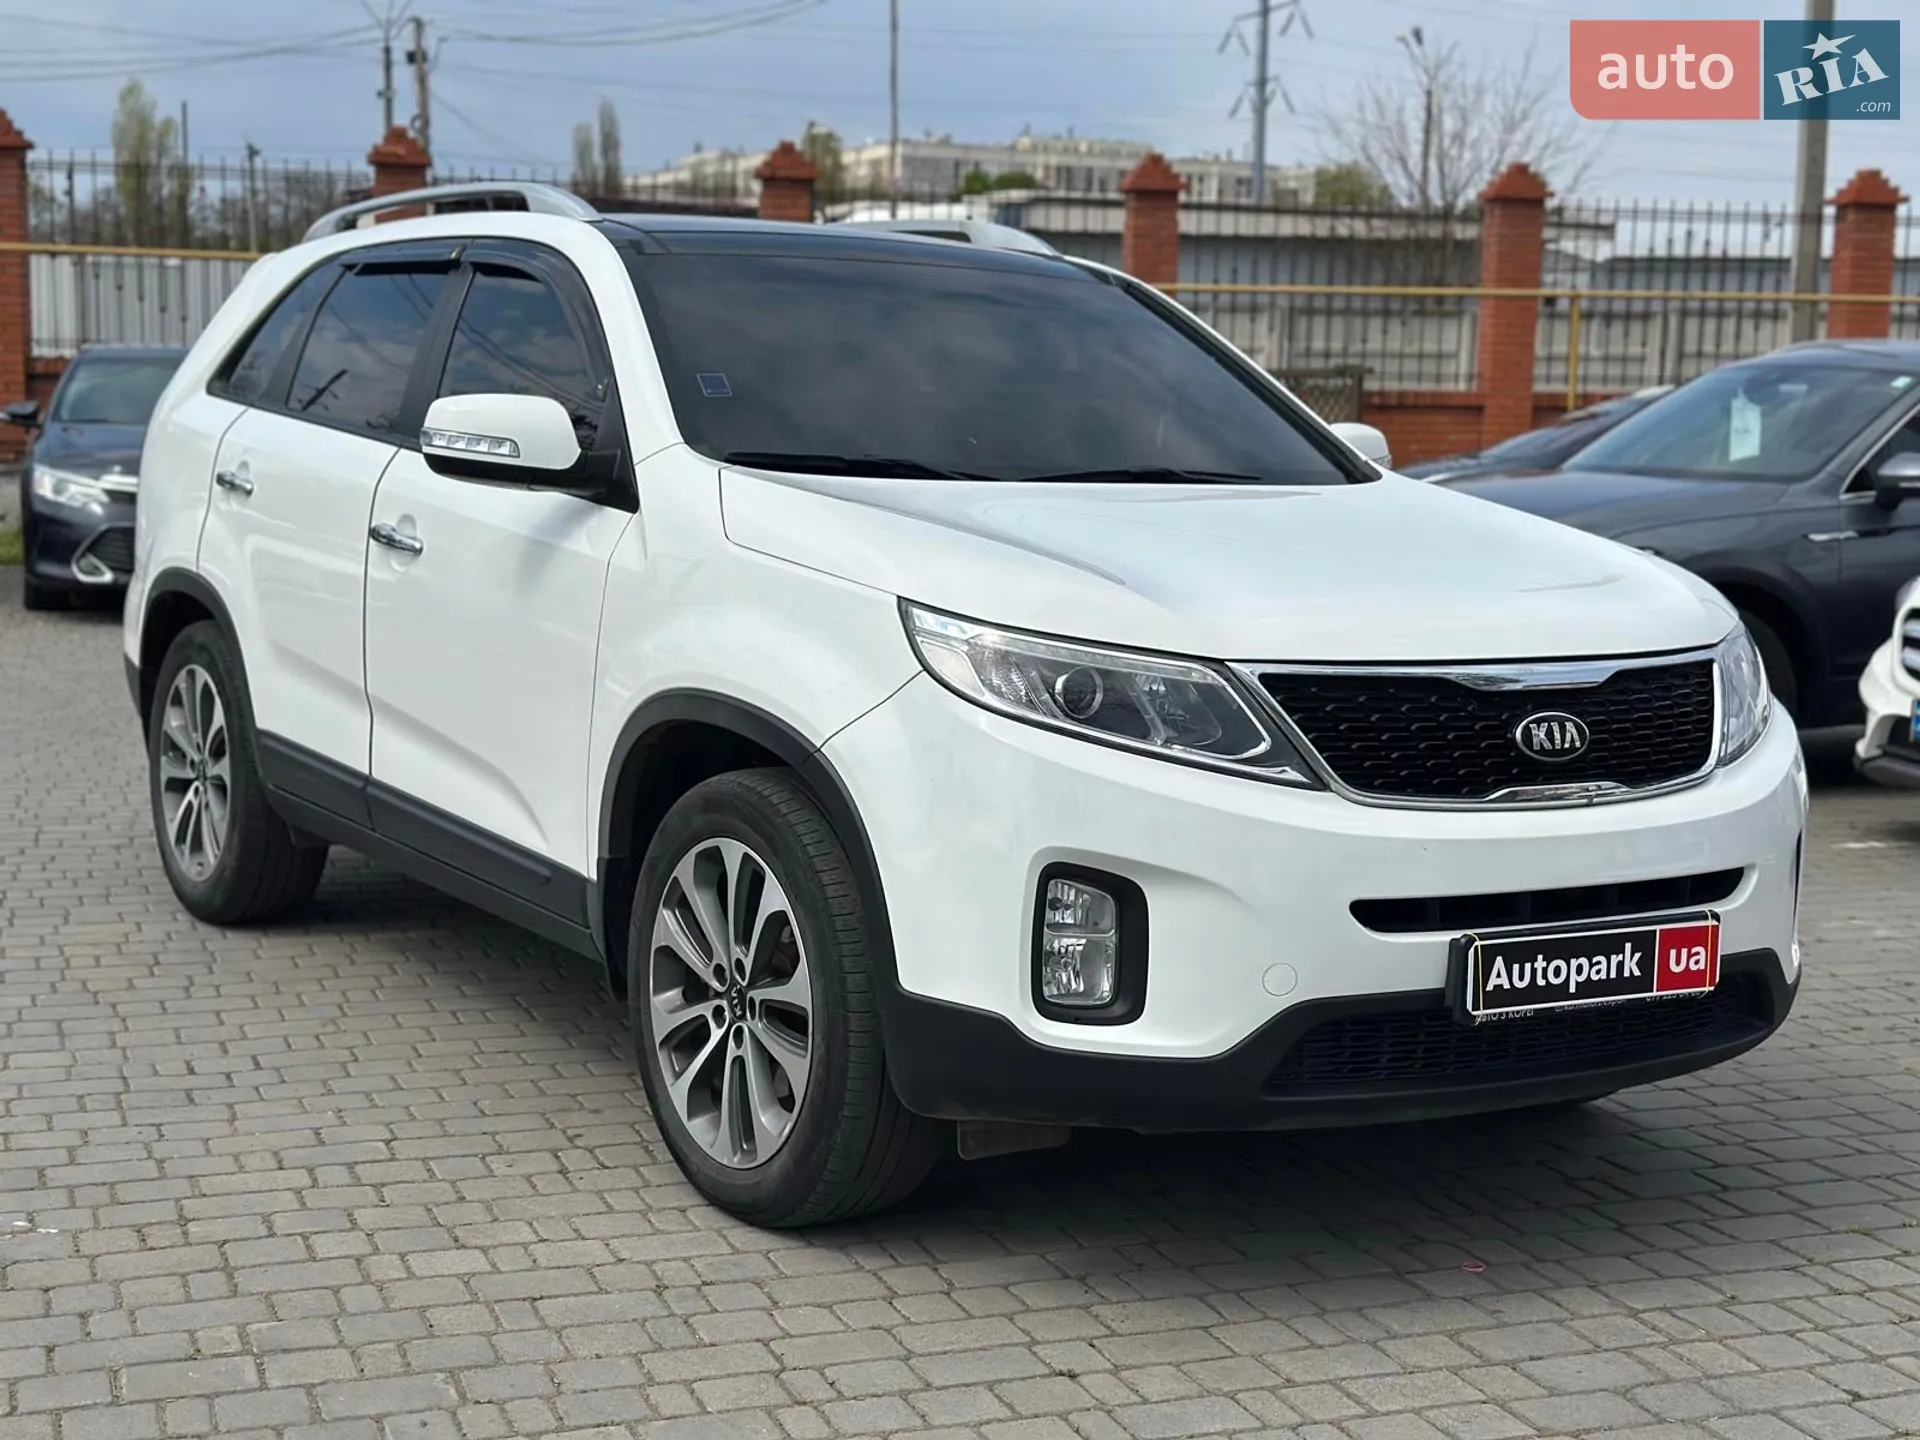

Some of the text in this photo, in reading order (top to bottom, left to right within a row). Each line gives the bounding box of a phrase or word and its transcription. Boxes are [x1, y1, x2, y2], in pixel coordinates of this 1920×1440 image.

[1528, 721, 1582, 750] KIA
[1485, 942, 1707, 993] Autopark ua
